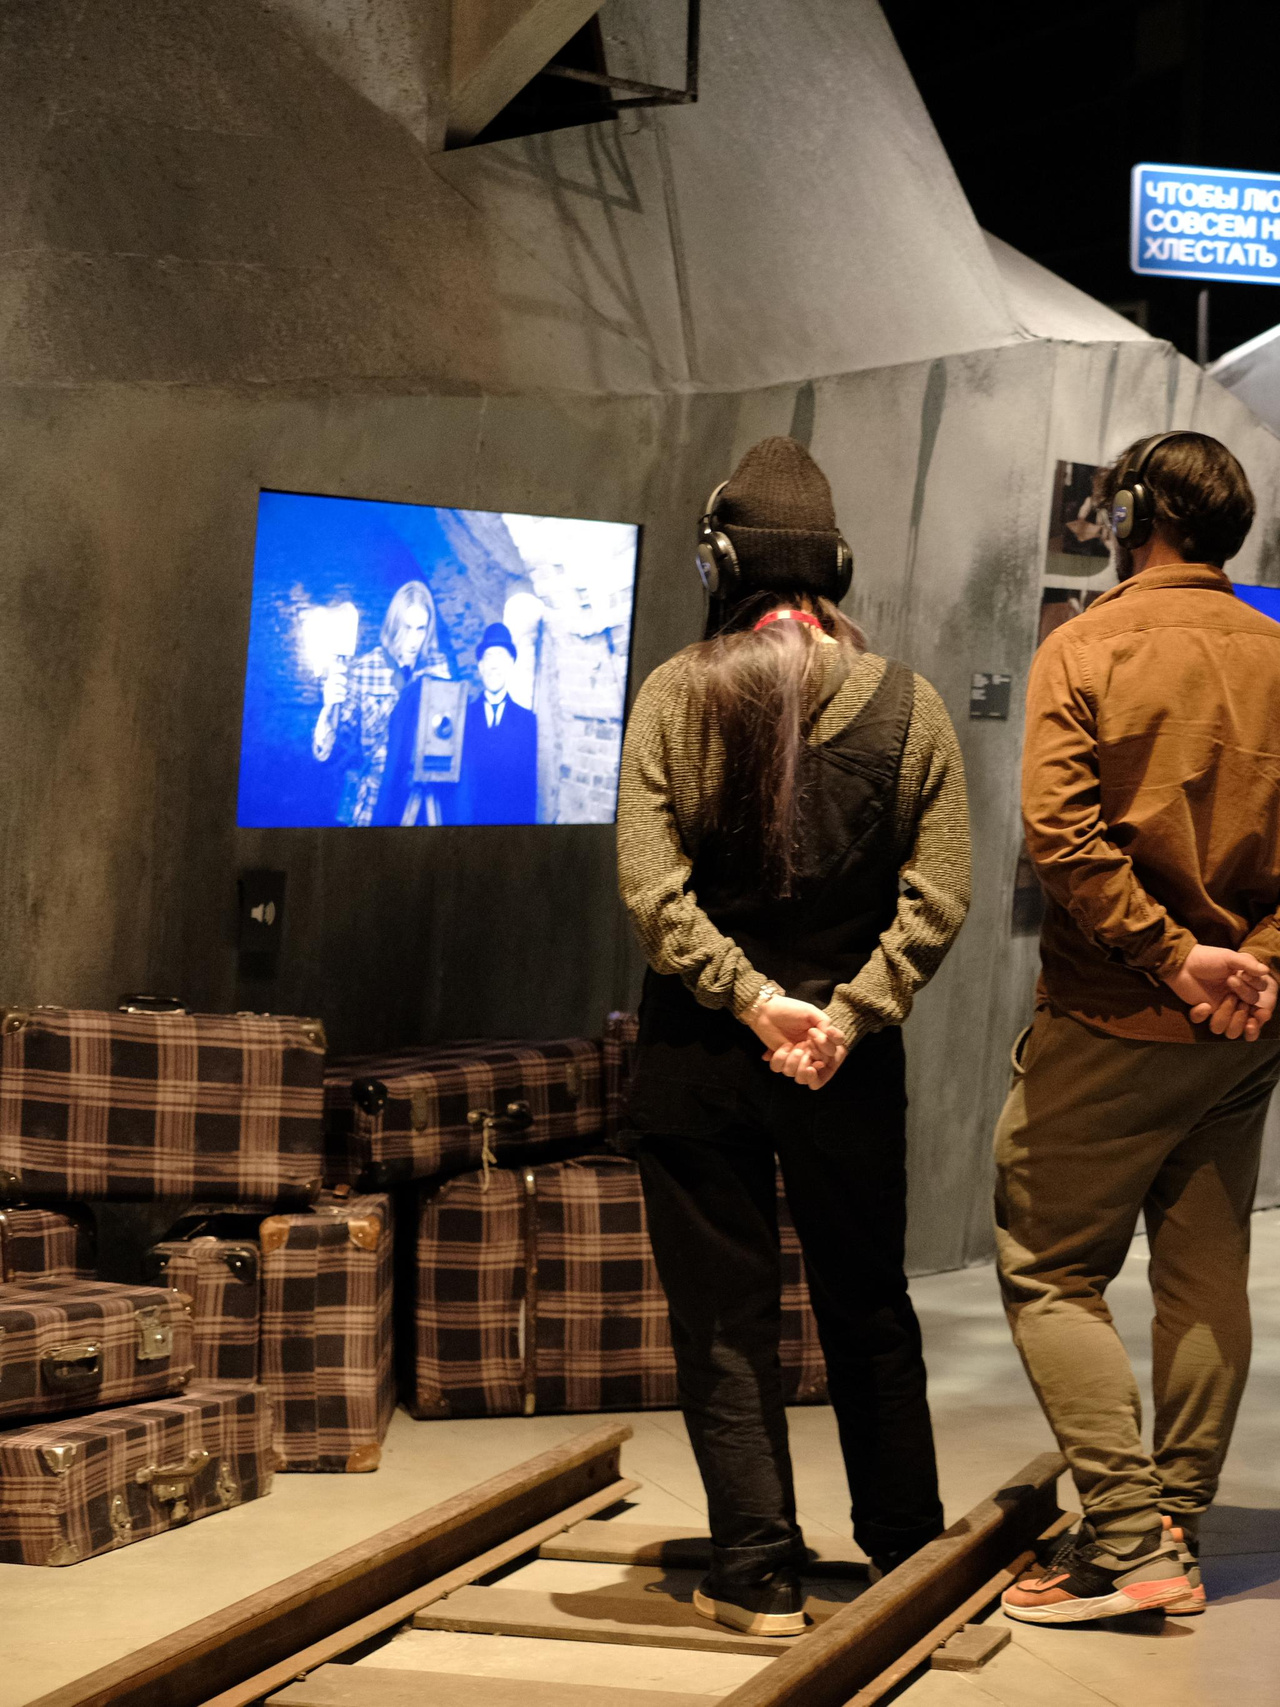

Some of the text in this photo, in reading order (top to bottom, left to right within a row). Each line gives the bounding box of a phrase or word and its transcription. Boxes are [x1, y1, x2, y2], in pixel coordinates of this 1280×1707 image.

[1145, 181, 1238, 210] ЧТОБЫ
[1145, 209, 1257, 238] СОВСЕМ
[1143, 237, 1277, 268] ХЛЕСТАТЬ
